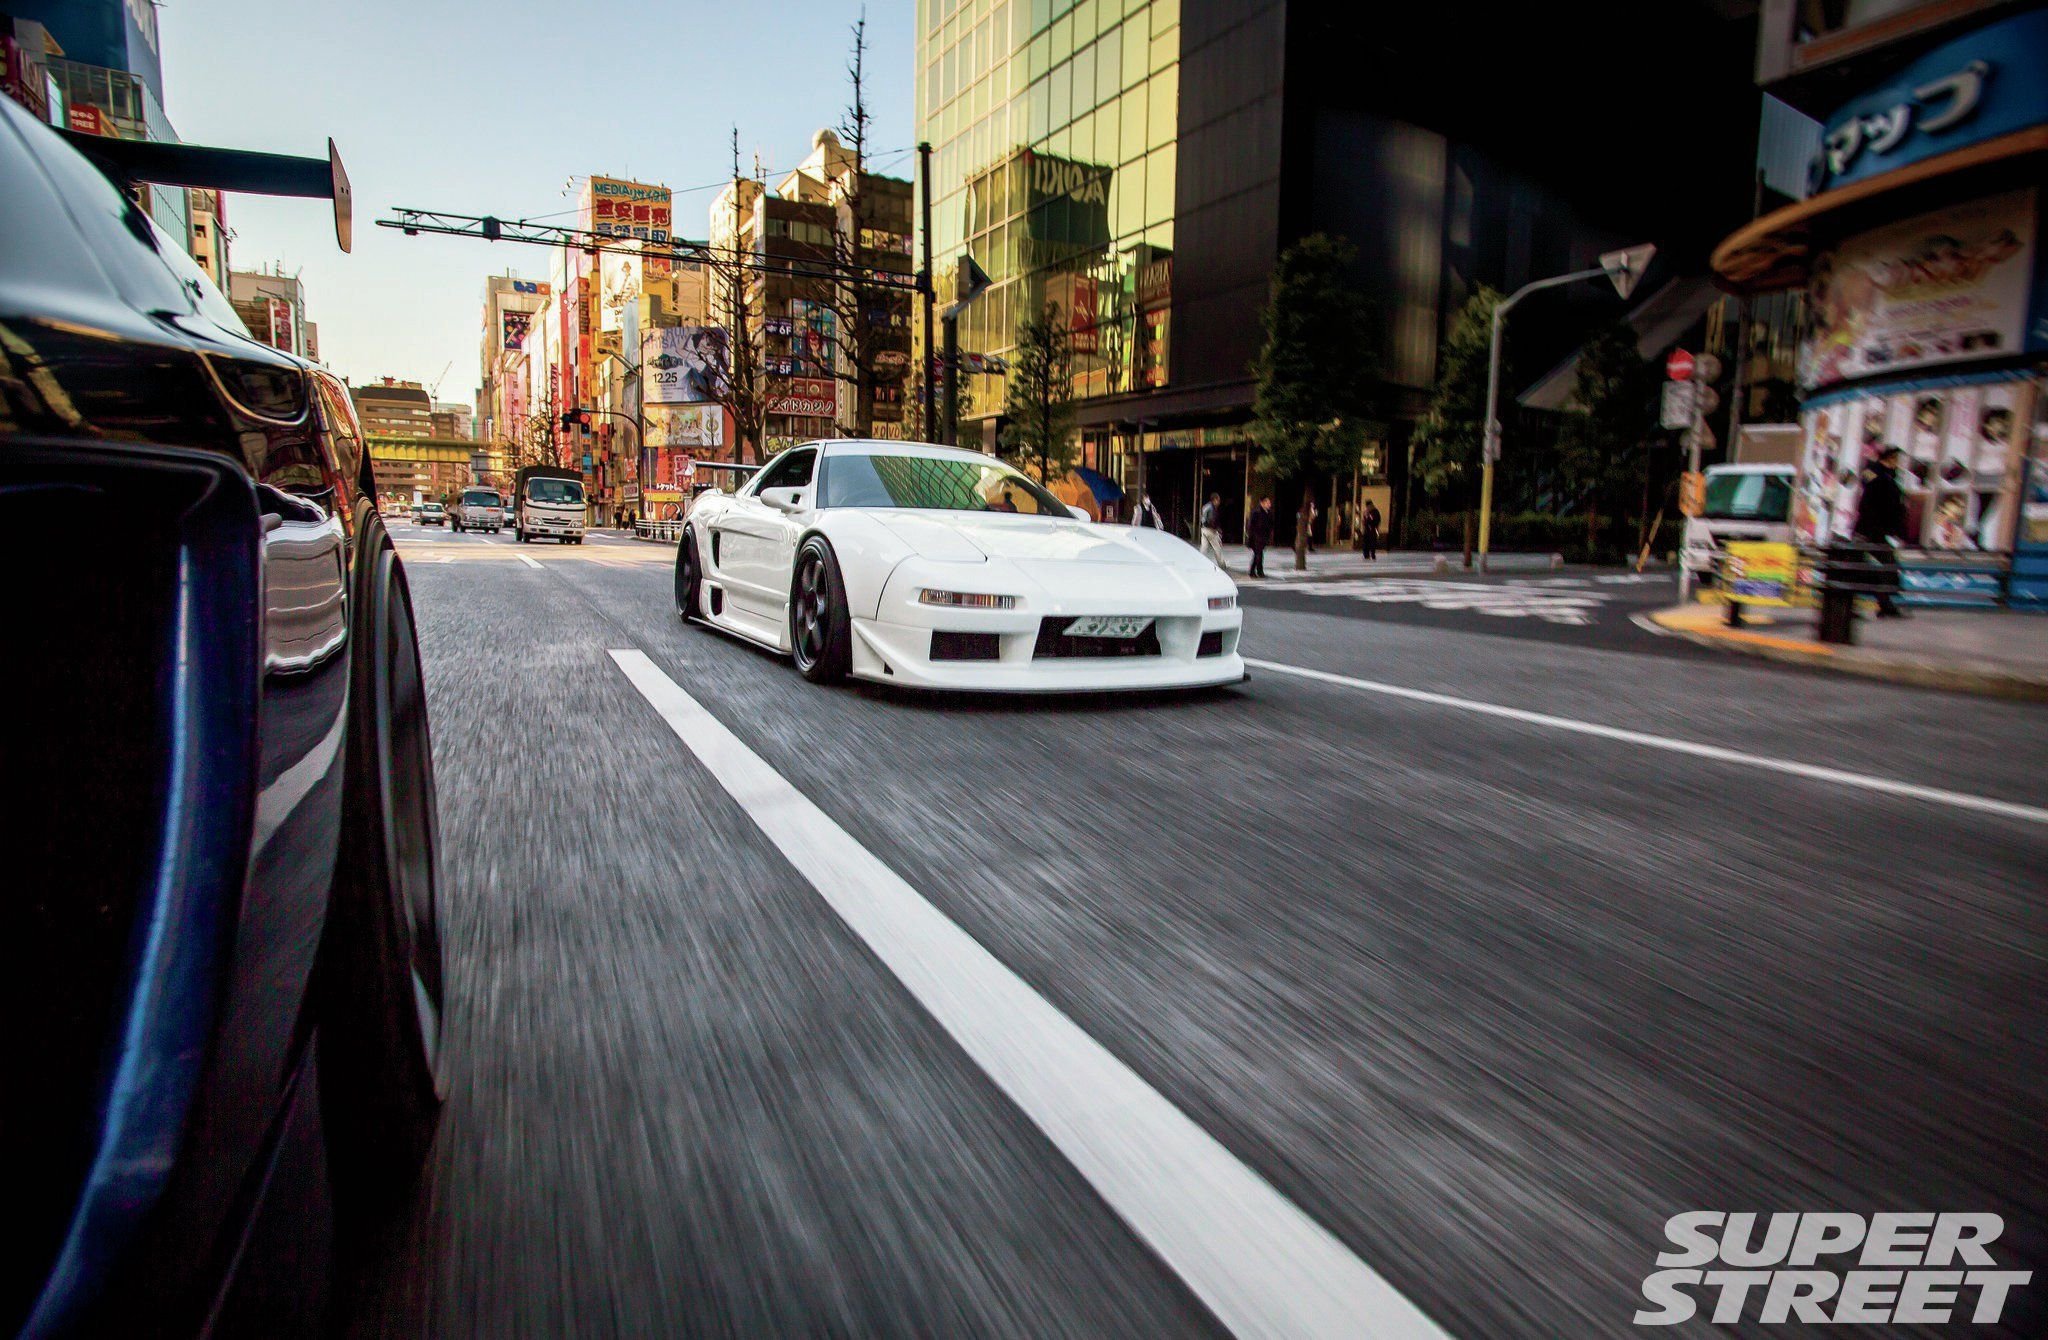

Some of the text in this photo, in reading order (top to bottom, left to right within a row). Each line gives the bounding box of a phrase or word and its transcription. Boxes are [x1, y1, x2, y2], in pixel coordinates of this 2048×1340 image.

[779, 325, 792, 336] 6F
[779, 364, 792, 375] 5F
[653, 372, 678, 384] 12.25
